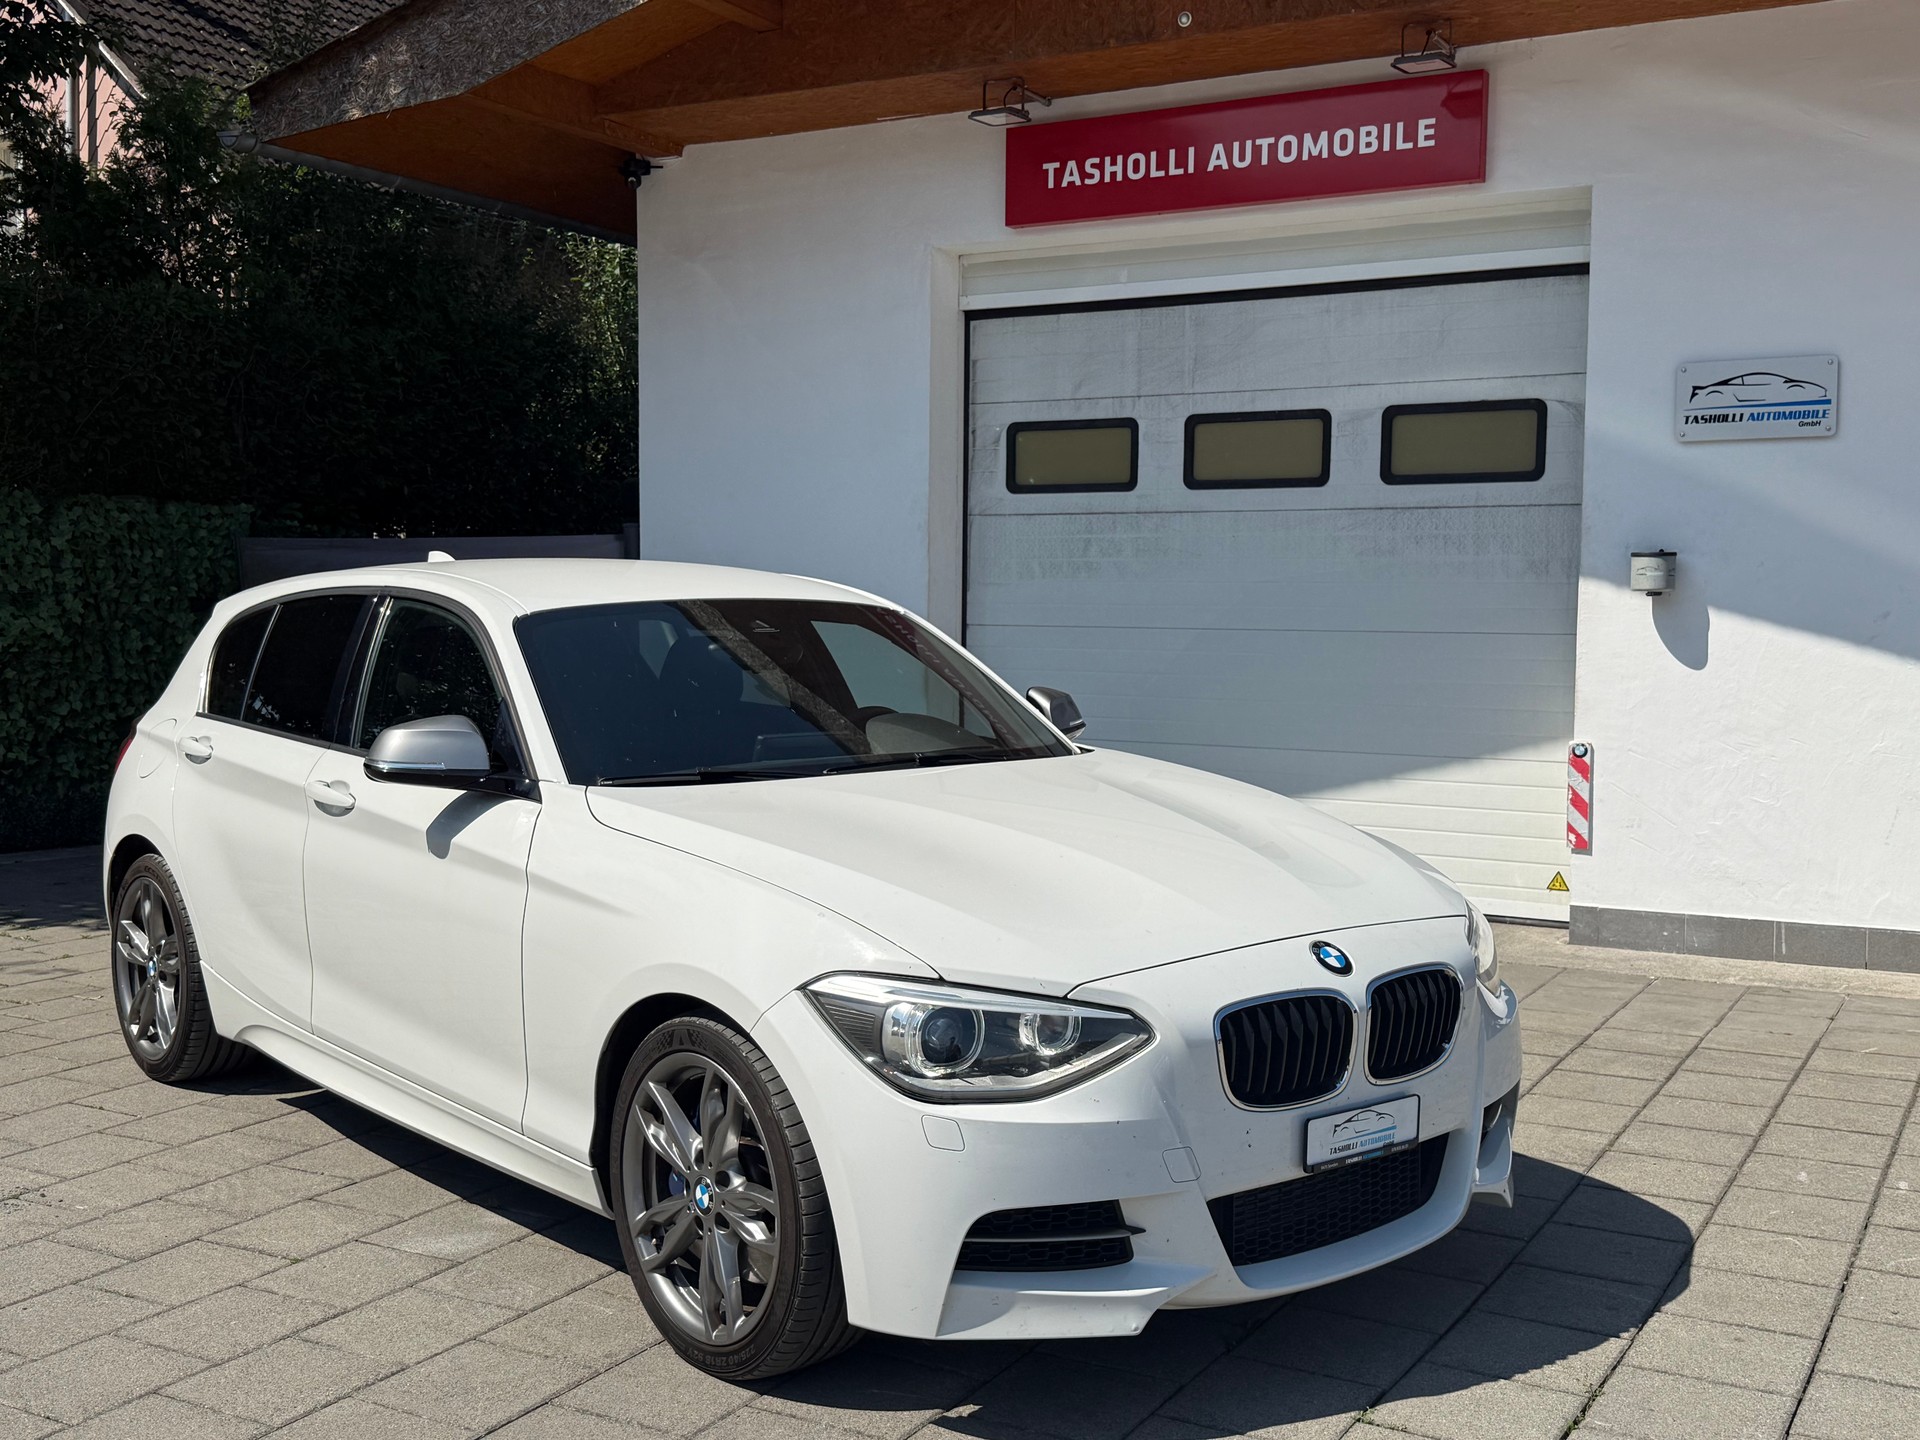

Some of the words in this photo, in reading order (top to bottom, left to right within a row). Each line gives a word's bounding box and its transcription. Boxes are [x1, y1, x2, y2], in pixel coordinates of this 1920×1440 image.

[1042, 146, 1195, 189] TASHOLLI
[1207, 117, 1436, 172] AUTOMOBILE
[1683, 412, 1744, 425] TASHOLLI
[1746, 408, 1831, 422] AUTOMOBILE
[1798, 419, 1822, 428] GmbH
[1329, 1141, 1359, 1156] TASHOLLI
[728, 1344, 756, 1364] 225/40
